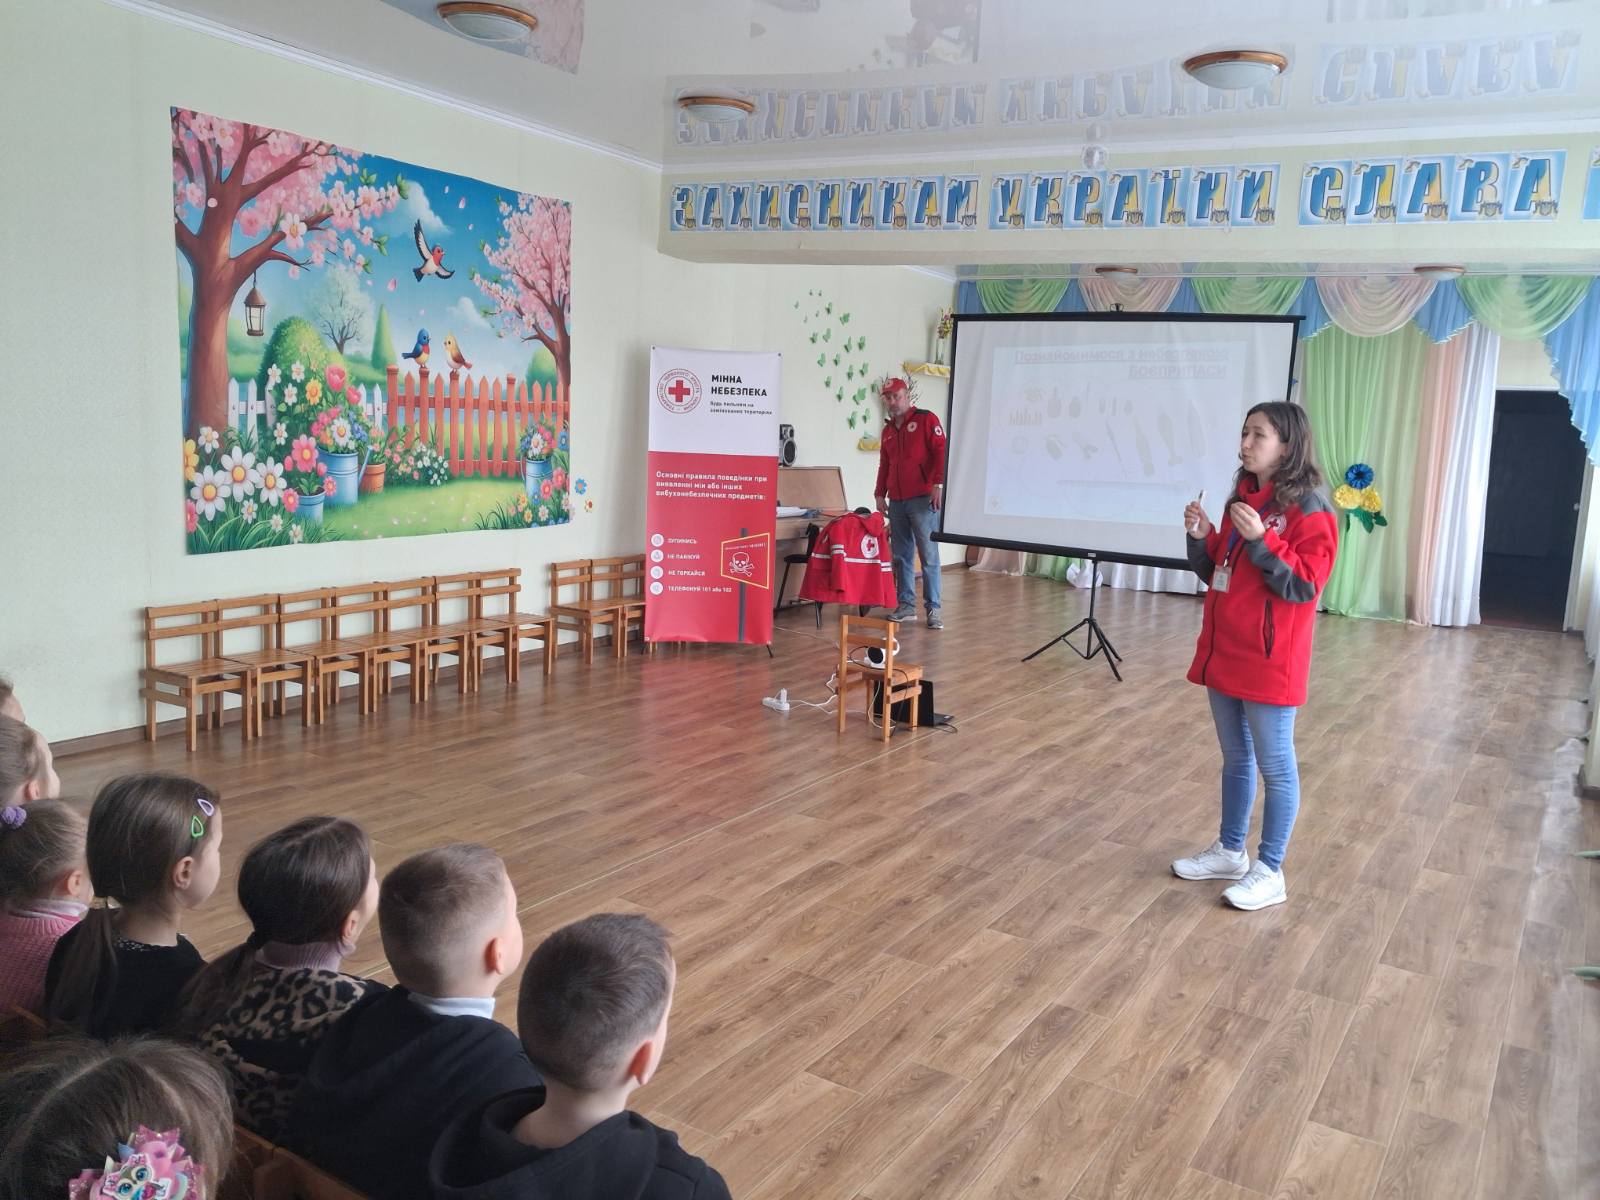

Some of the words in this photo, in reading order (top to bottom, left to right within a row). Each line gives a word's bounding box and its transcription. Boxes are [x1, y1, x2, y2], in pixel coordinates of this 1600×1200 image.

[675, 179, 979, 228] ЗАХИСНИКАМ
[997, 169, 1276, 224] УКРАЇНИ
[1308, 157, 1557, 220] СЛАВА
[711, 375, 743, 384] МІННА
[711, 386, 768, 397] НЕБЕЗПЕКА
[656, 471, 685, 479] Основні
[717, 474, 753, 482] поведінки
[754, 475, 768, 483] при
[656, 481, 693, 489] виявленні
[694, 482, 706, 490] мін
[707, 482, 720, 490] або
[721, 482, 743, 491] інших
[656, 489, 727, 499] вибухонебезпечних
